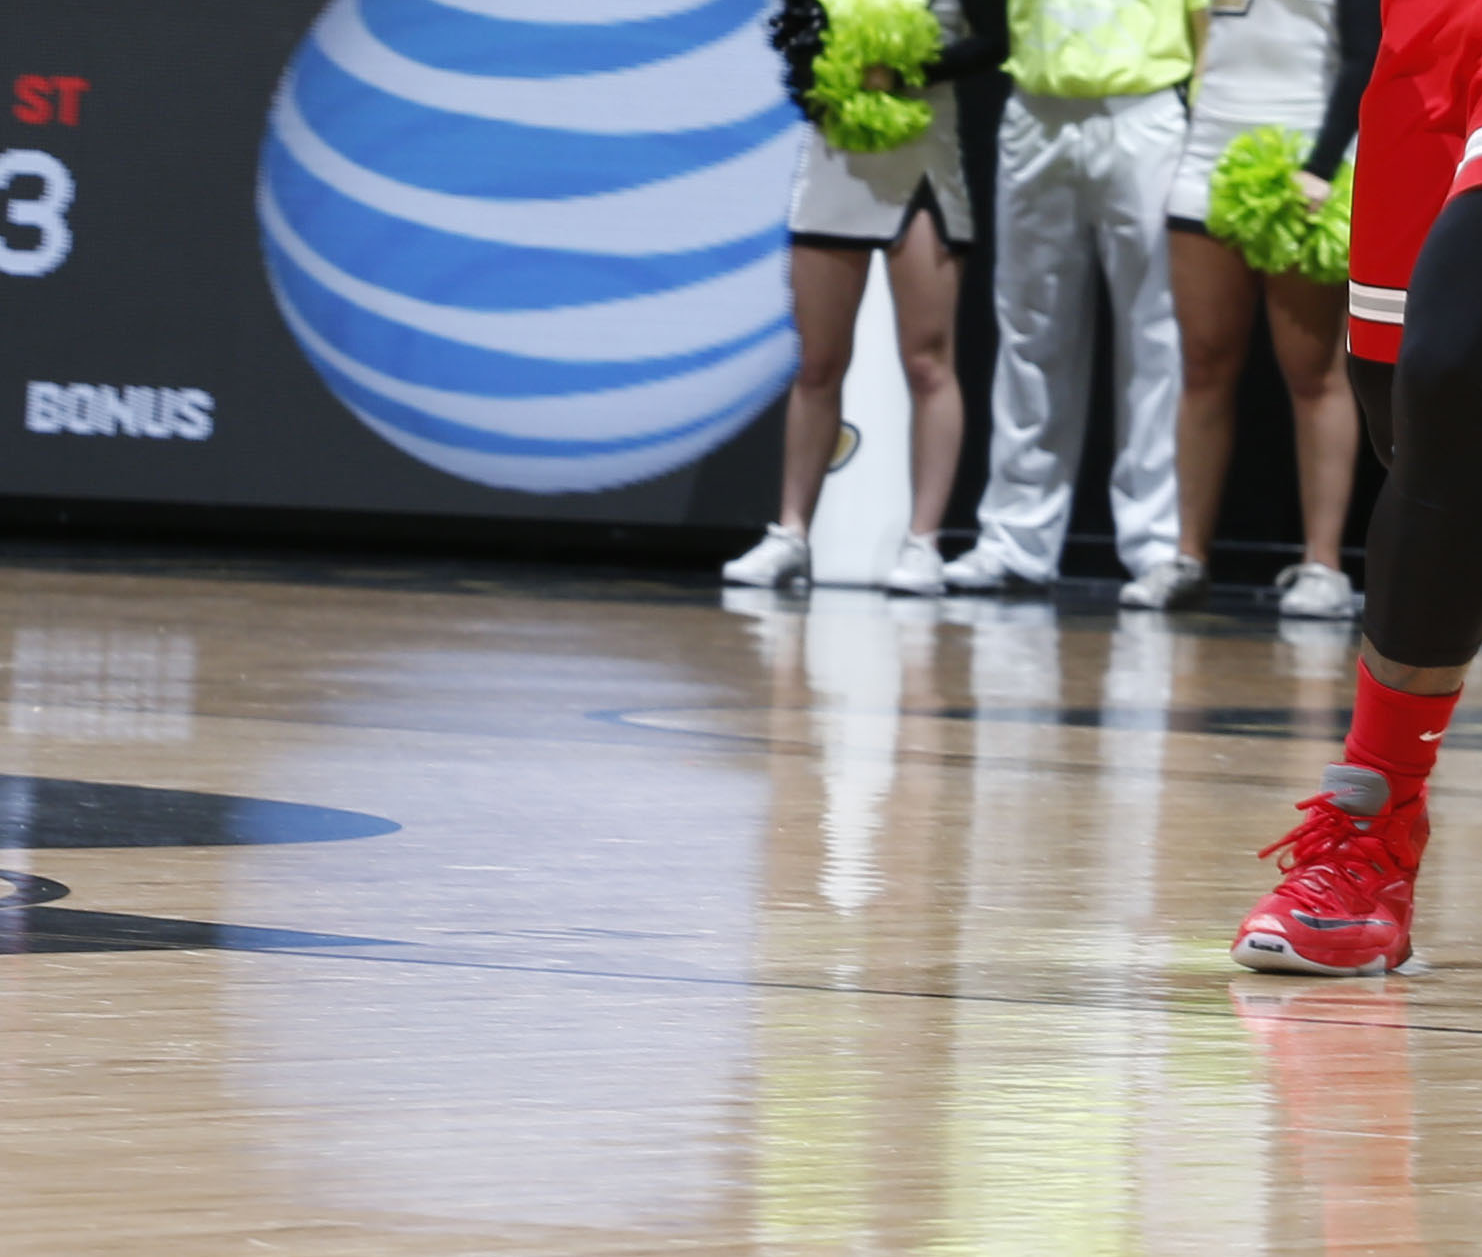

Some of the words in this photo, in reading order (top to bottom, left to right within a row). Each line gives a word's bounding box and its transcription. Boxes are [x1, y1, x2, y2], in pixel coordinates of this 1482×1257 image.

[12, 74, 92, 126] ST
[0, 148, 76, 277] 3
[25, 380, 216, 441] BONUS
